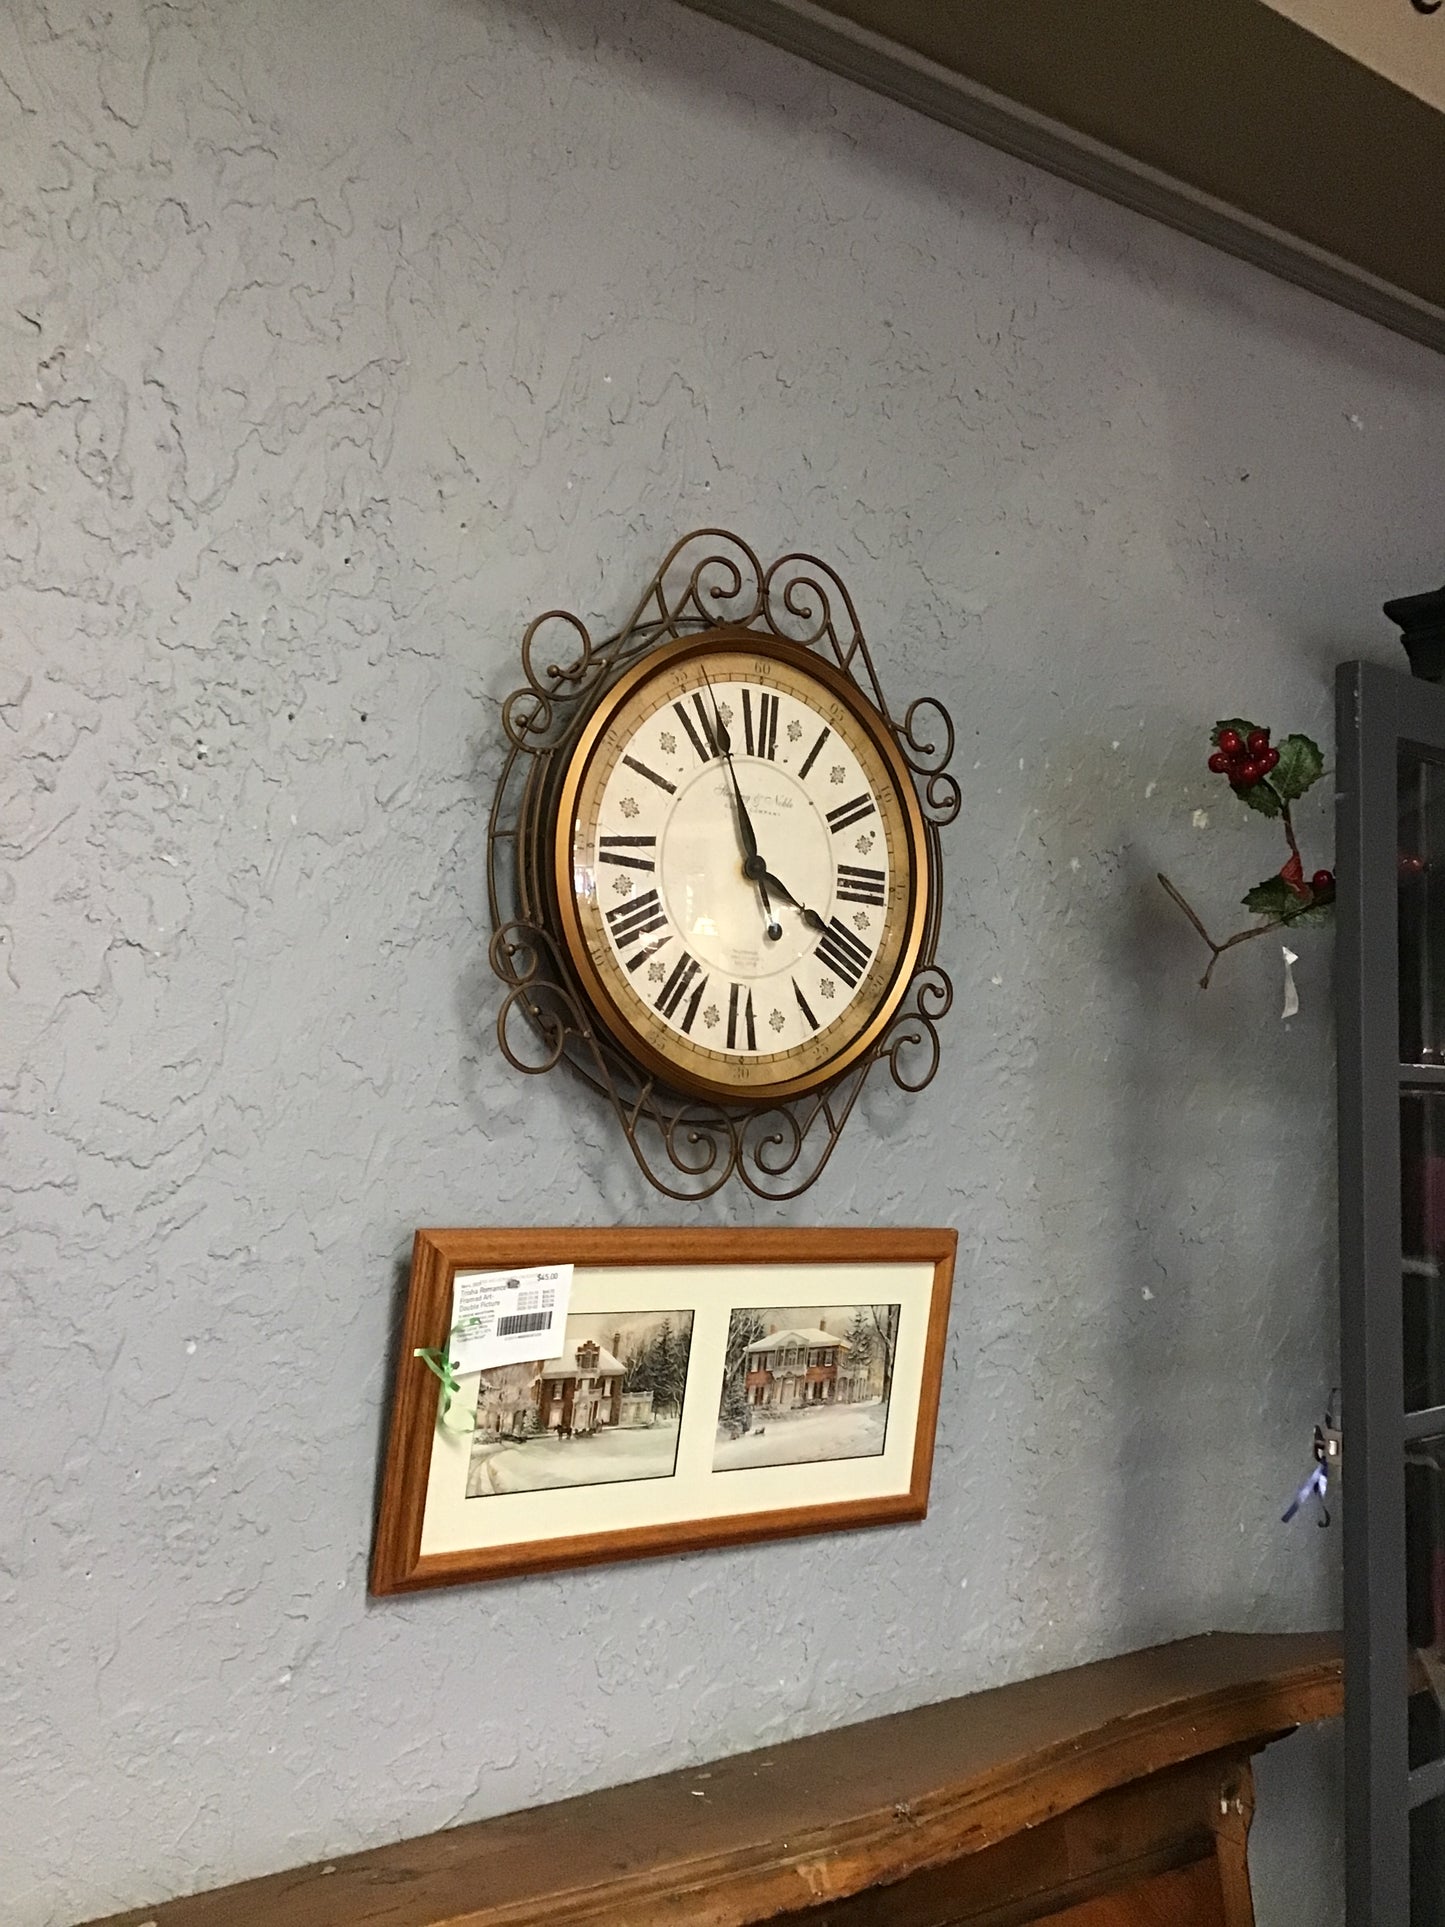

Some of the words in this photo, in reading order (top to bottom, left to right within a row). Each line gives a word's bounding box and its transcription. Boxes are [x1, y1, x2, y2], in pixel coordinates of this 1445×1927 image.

[754, 661, 772, 675] 60
[825, 792, 877, 835] II
[836, 864, 885, 907] III
[537, 1272, 559, 1282] $45.00
[459, 1295, 482, 1304] Framed
[459, 1303, 480, 1312] Double
